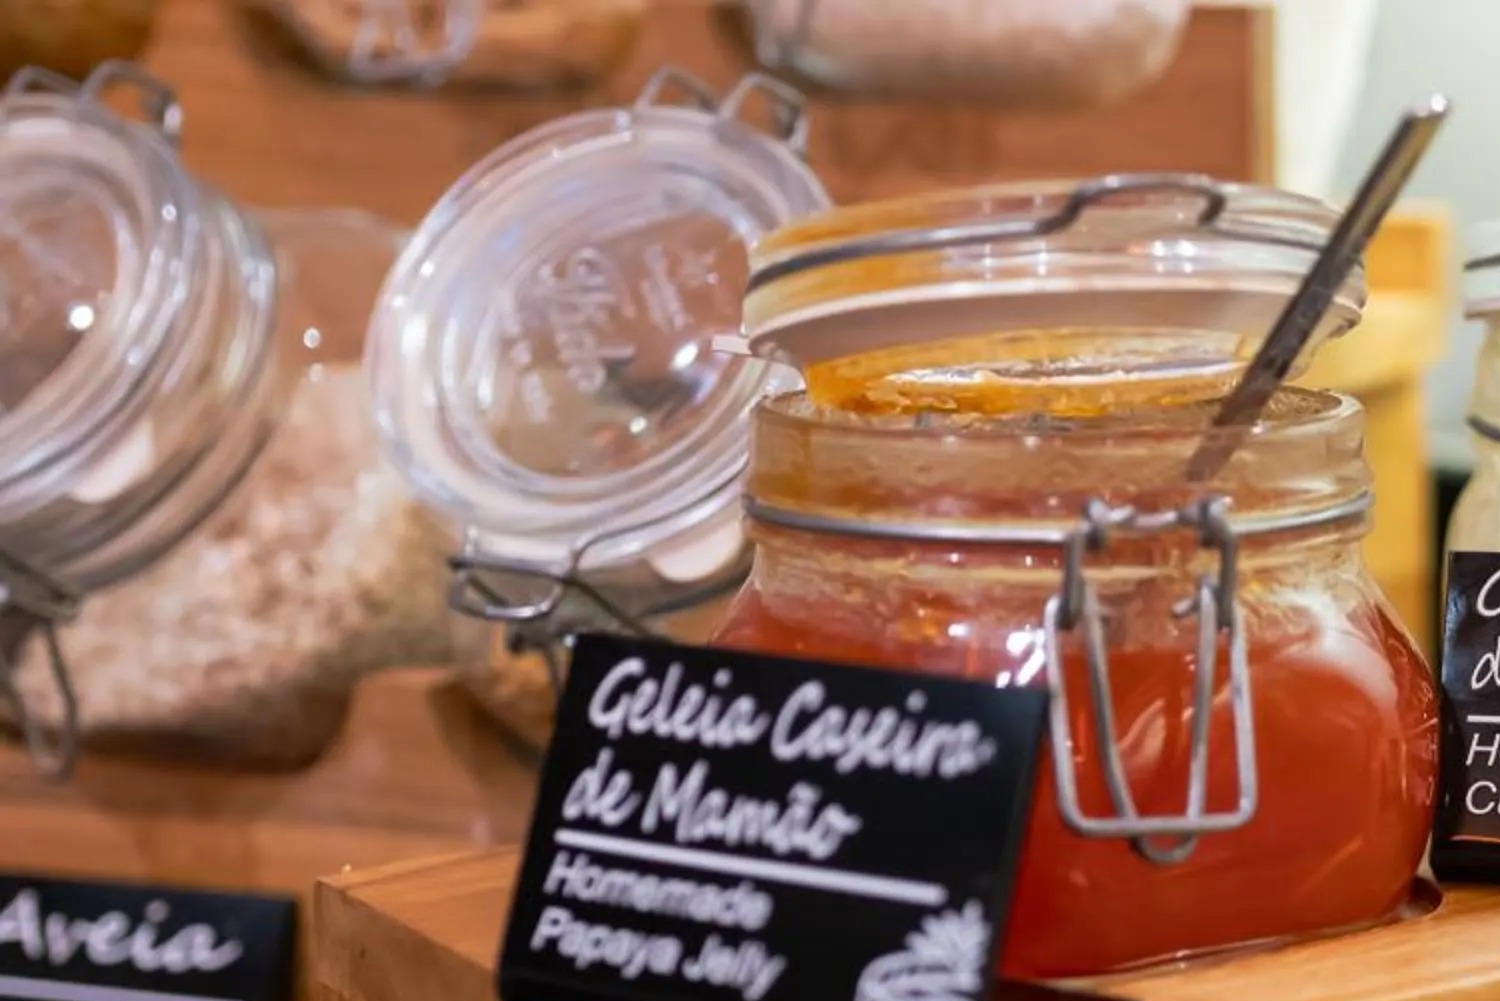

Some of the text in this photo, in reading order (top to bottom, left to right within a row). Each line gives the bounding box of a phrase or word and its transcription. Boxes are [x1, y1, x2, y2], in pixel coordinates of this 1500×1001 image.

[587, 656, 997, 778] Geleia Caseira
[562, 748, 861, 860] de Mamão
[0, 885, 244, 973] Aveia
[543, 851, 774, 931] Homemade
[530, 905, 787, 1001] Papaya Jelly
